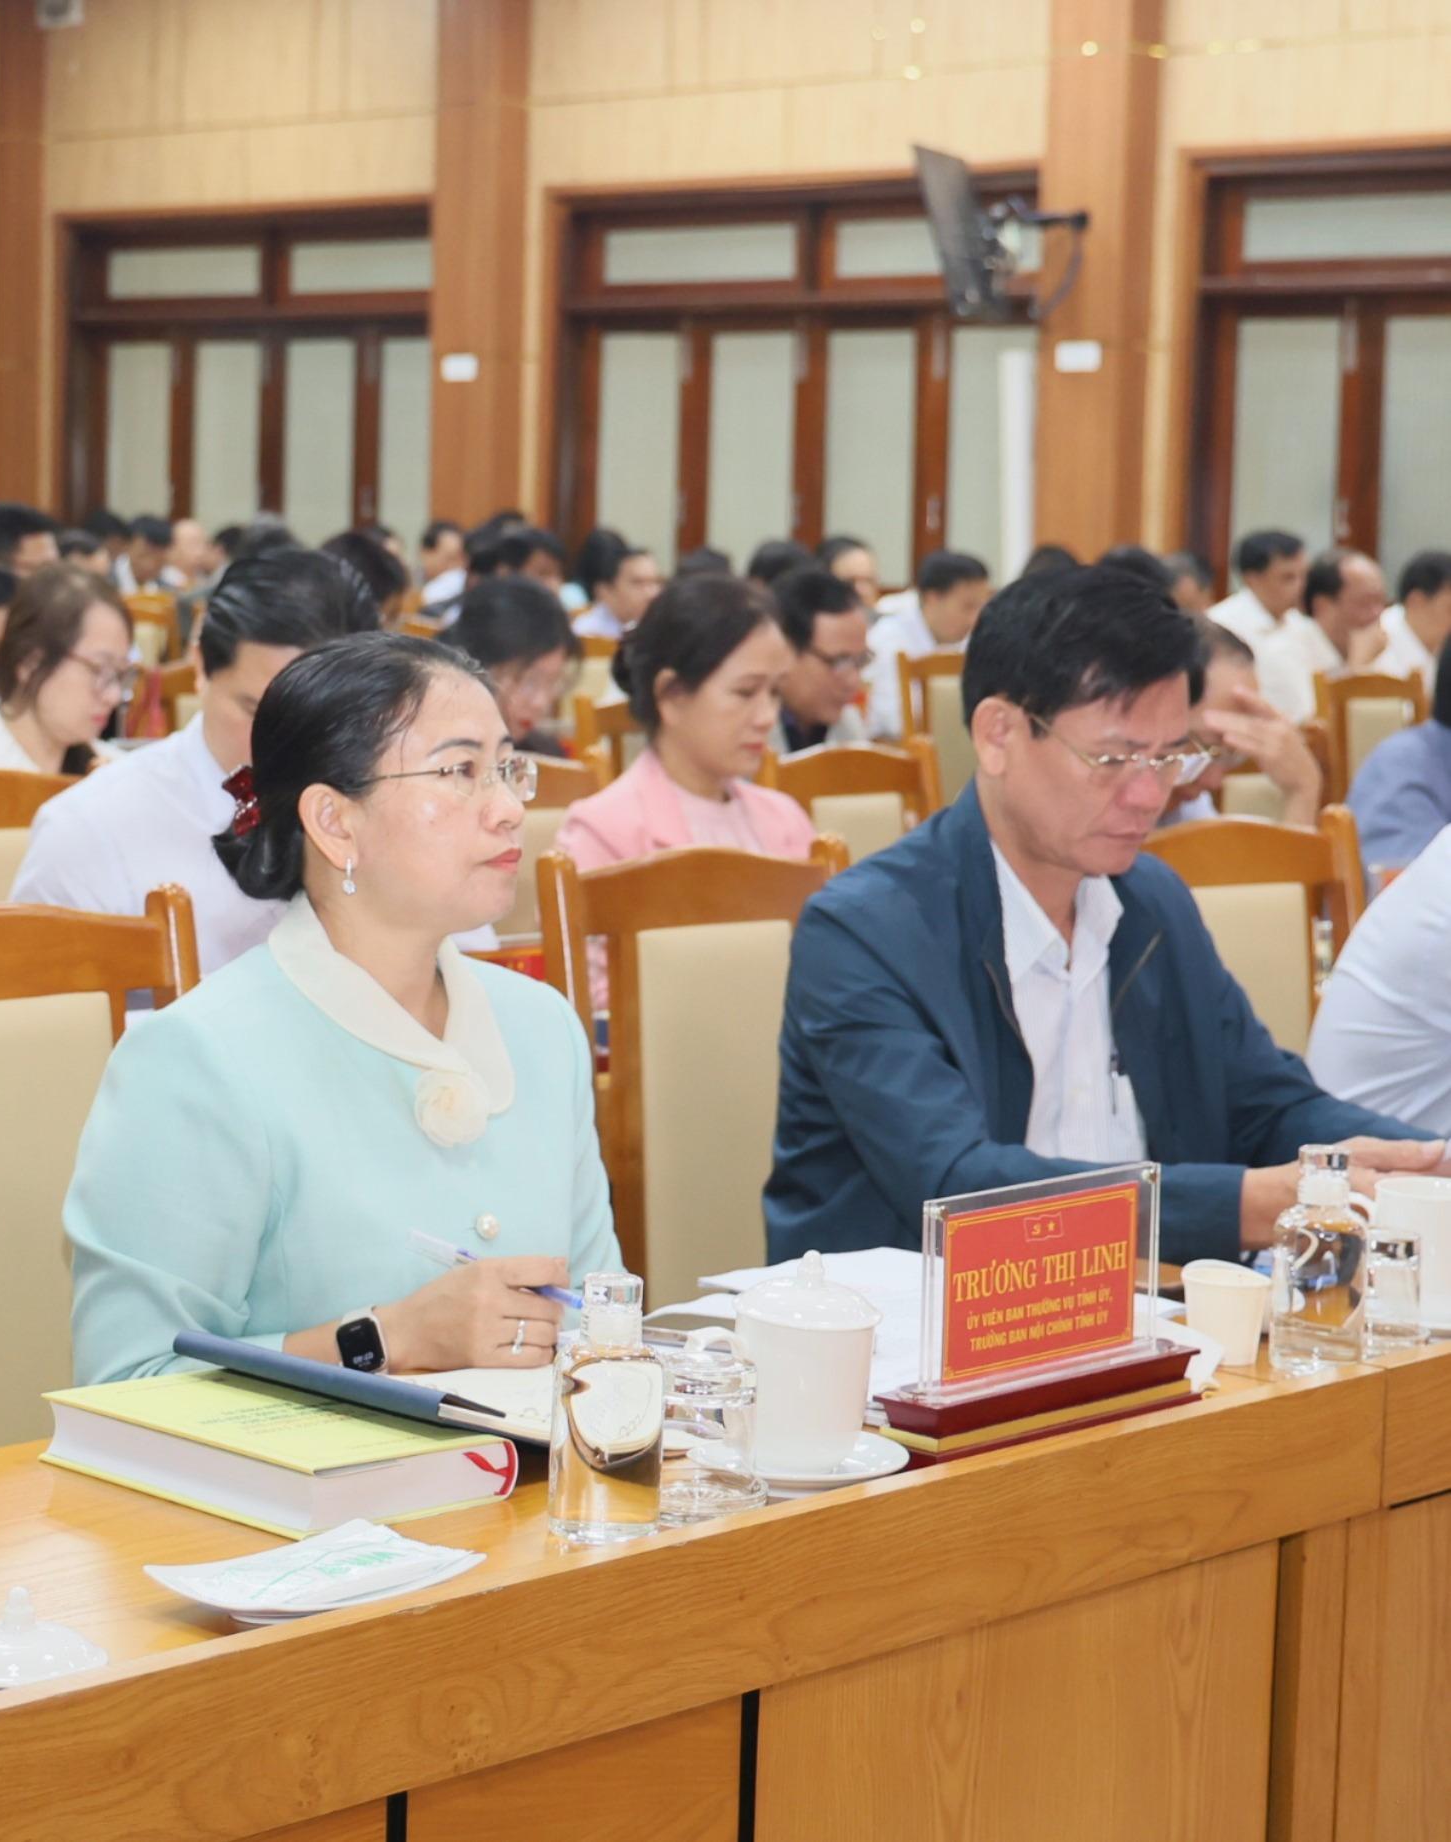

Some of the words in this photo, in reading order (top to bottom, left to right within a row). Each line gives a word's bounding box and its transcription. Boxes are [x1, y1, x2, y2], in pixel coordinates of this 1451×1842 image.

[953, 1258, 1038, 1303] TRƯƠNG
[1042, 1251, 1076, 1287] THỊ
[1081, 1240, 1128, 1278] LINH
[982, 1306, 1003, 1327] VIÊN
[1005, 1305, 1024, 1322] BAN
[1008, 1328, 1027, 1345] BAN
